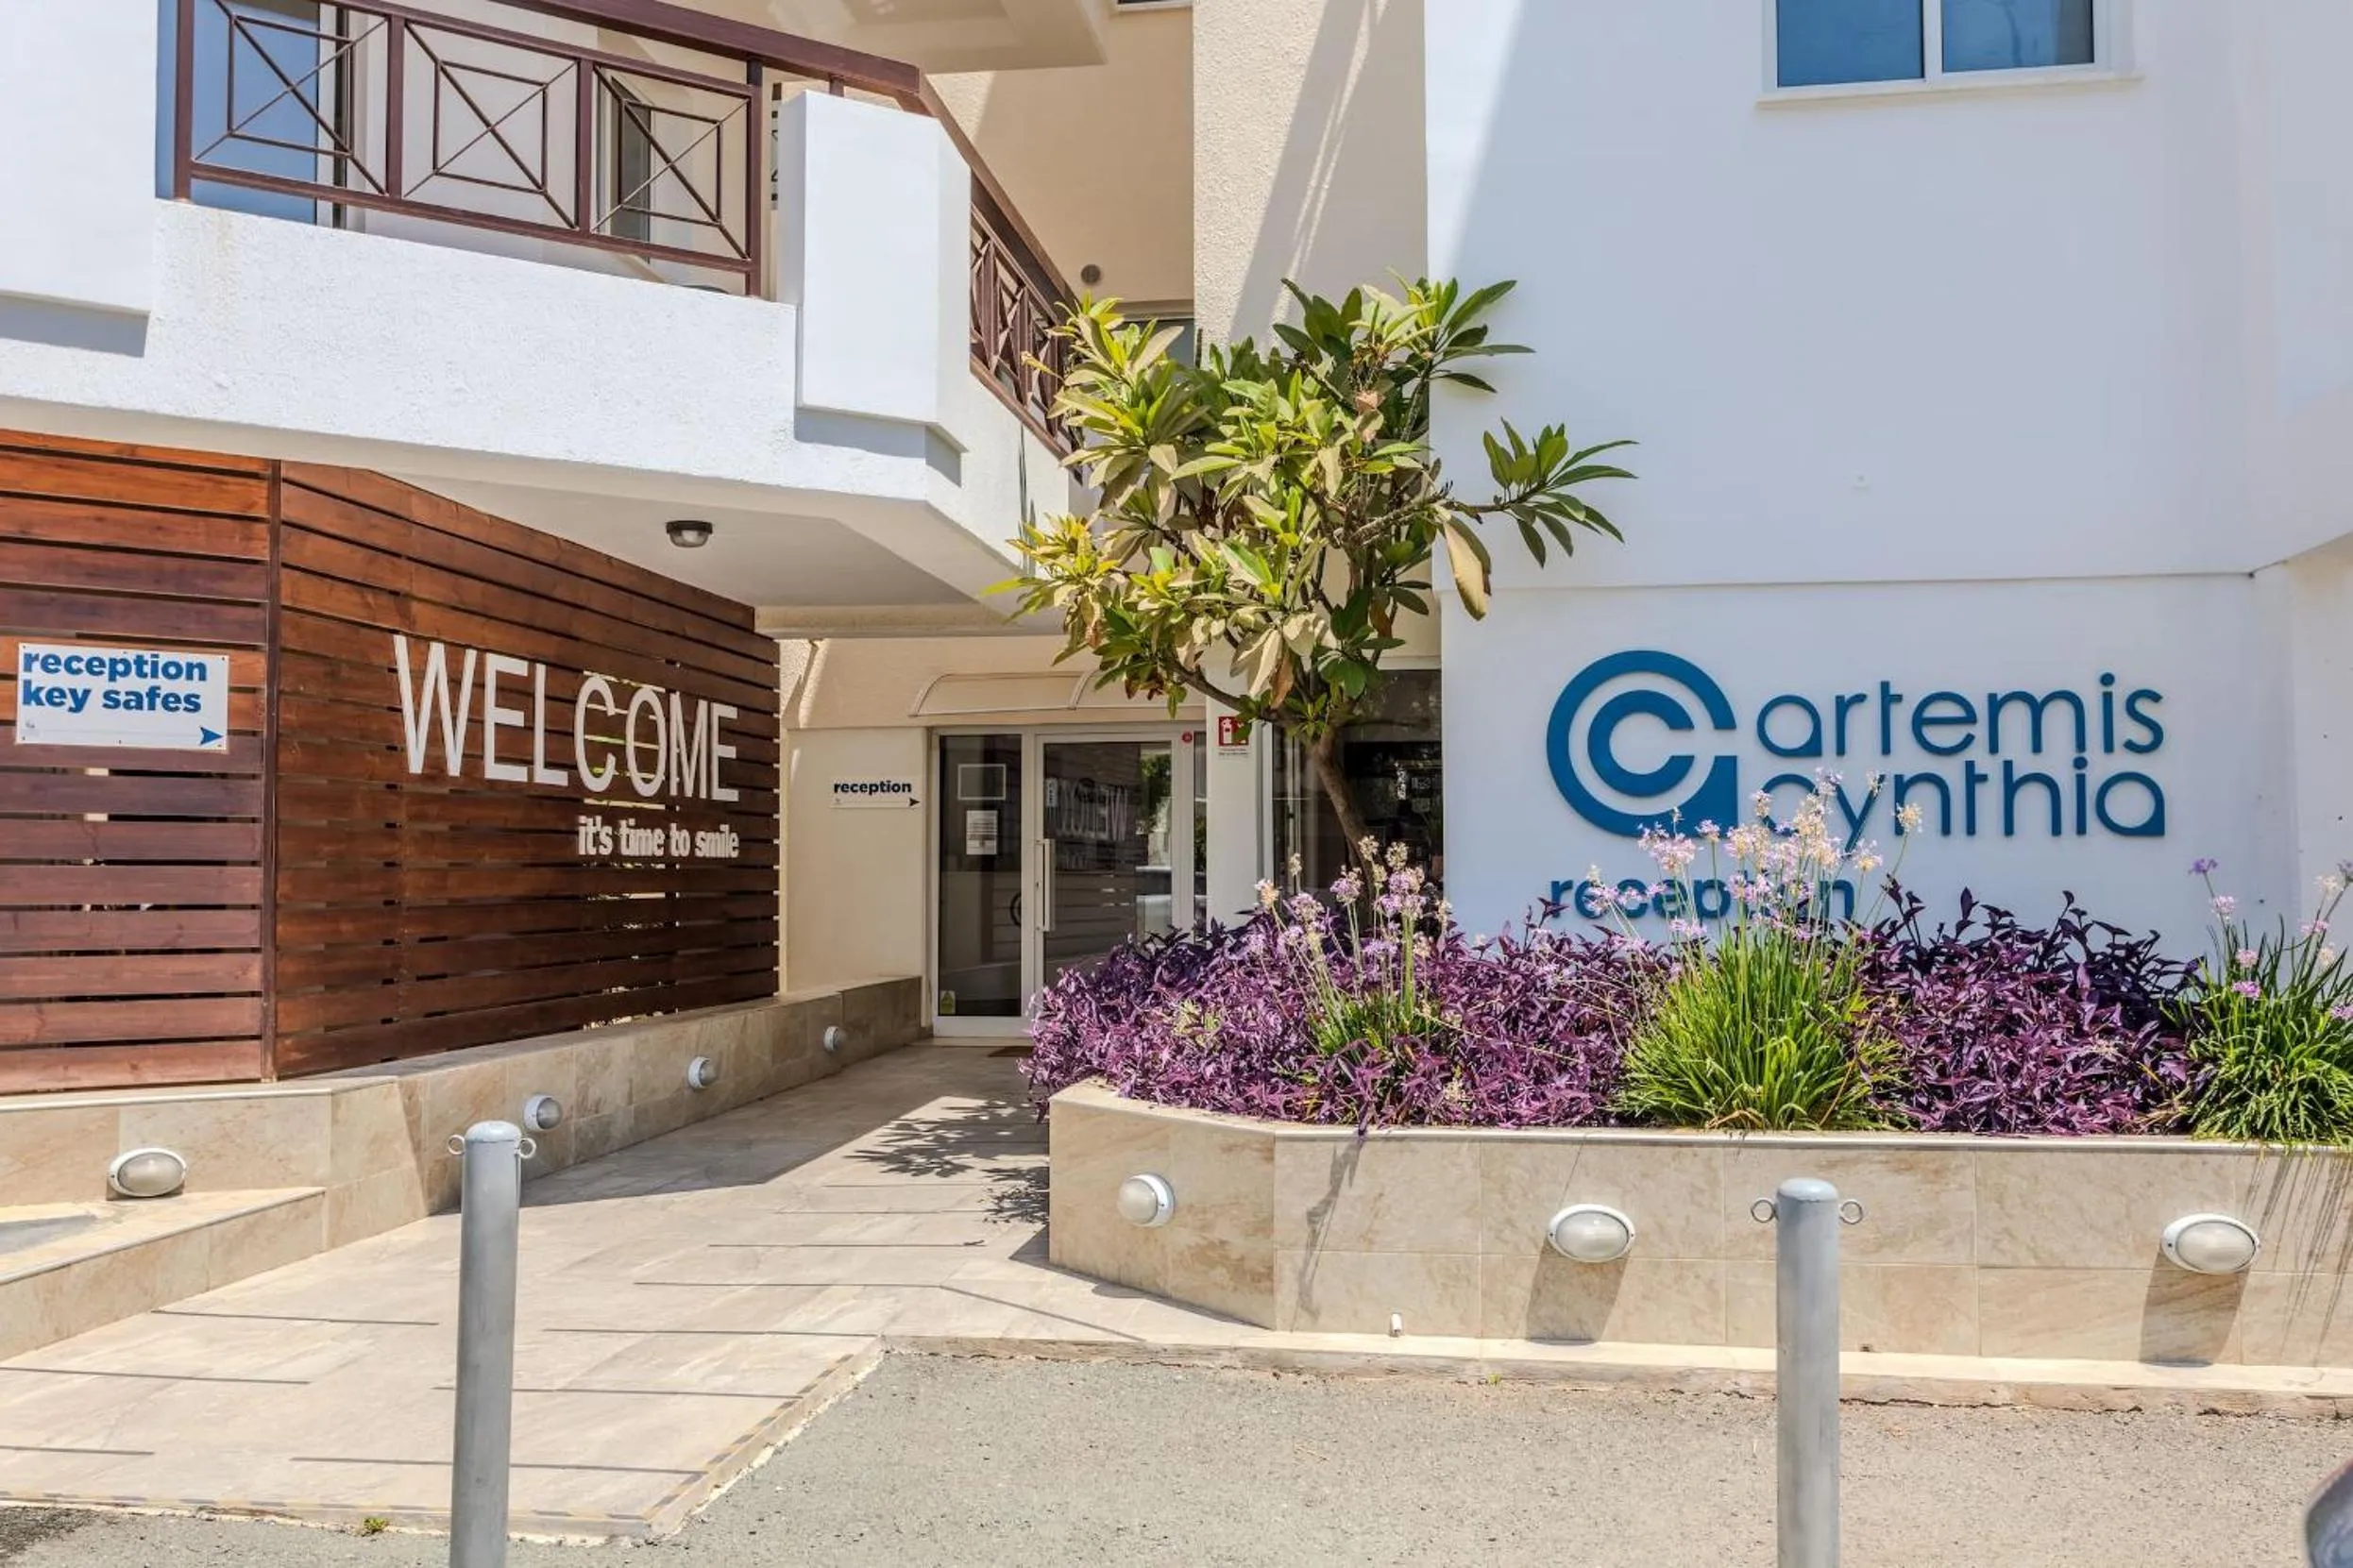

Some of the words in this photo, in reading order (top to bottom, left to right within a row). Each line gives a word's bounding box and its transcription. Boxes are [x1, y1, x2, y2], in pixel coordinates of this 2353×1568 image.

[23, 652, 208, 683] reception
[22, 679, 92, 714] key
[102, 686, 202, 714] safes
[393, 634, 739, 801] WELCOME
[1756, 672, 2164, 757] artemis
[834, 780, 912, 796] reception
[1756, 757, 2165, 853] cynthia
[578, 815, 613, 855] it's
[619, 818, 665, 856] time
[669, 822, 690, 856] to
[695, 824, 739, 858] smile
[1550, 870, 1855, 925] recepn
